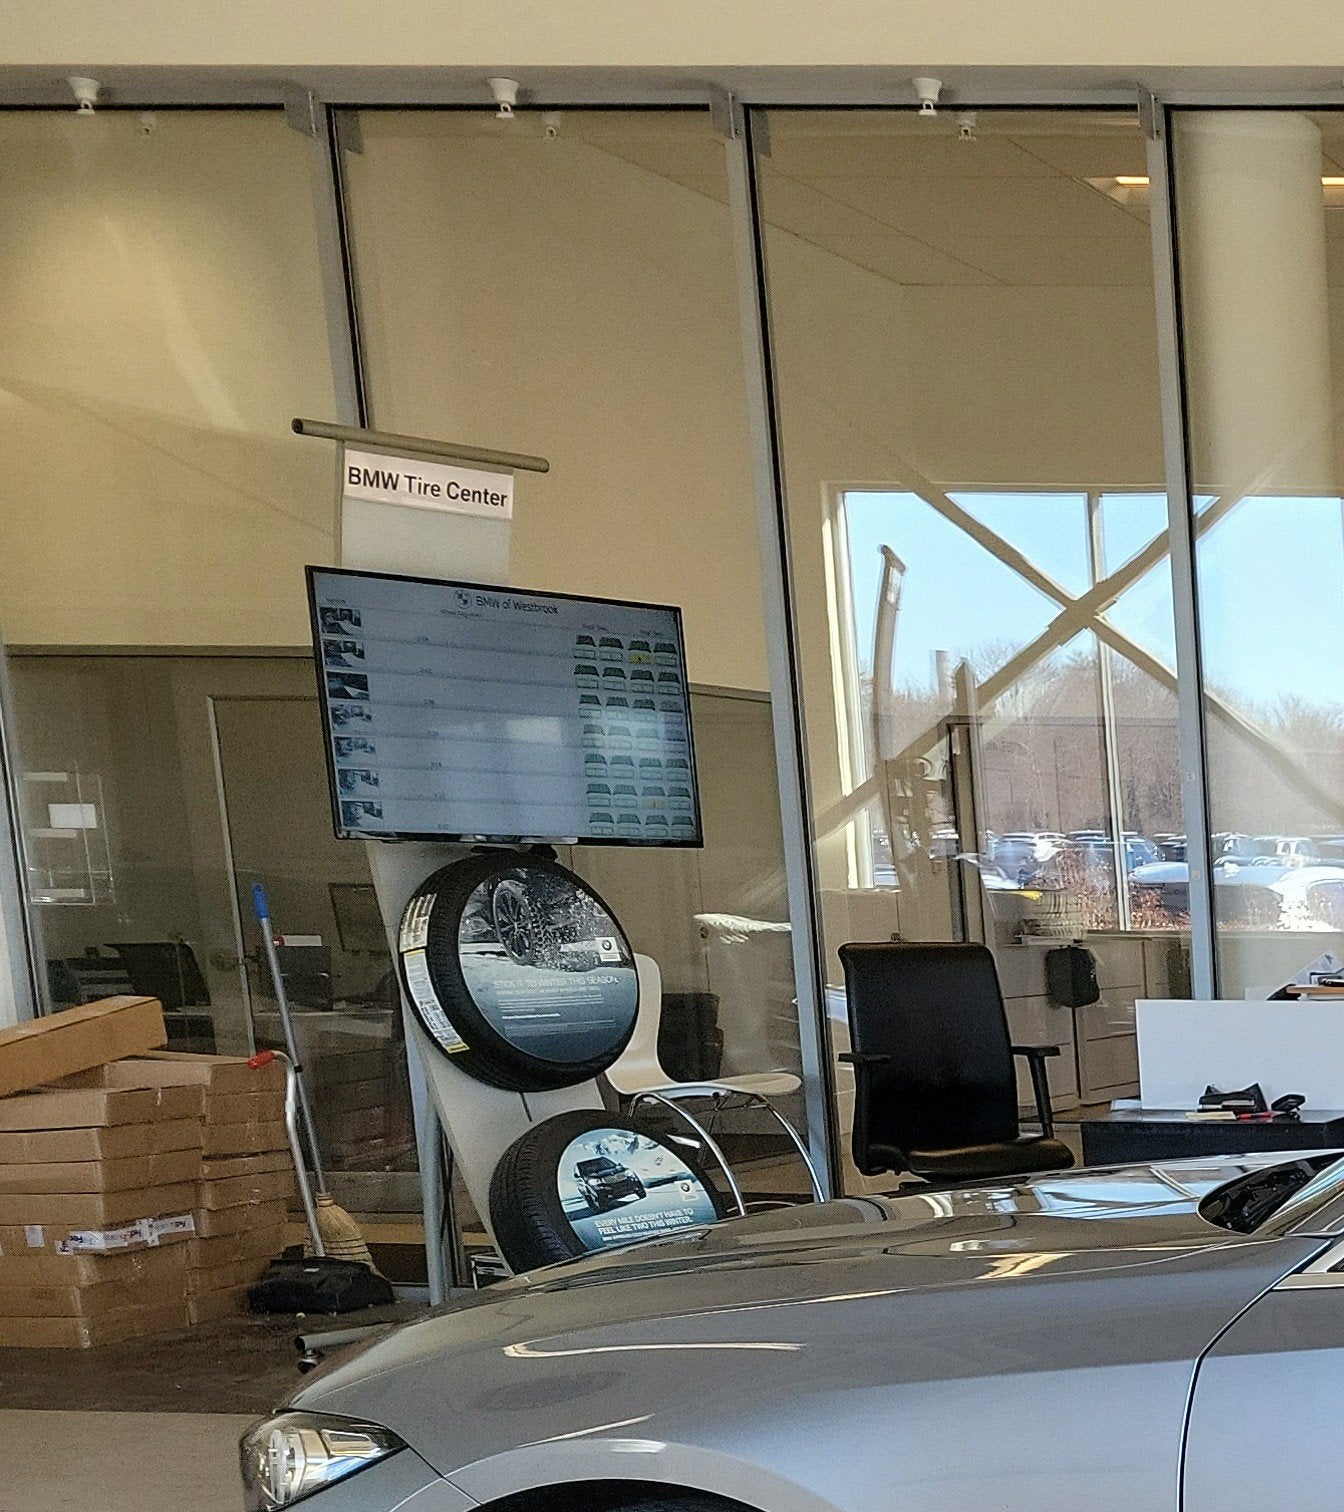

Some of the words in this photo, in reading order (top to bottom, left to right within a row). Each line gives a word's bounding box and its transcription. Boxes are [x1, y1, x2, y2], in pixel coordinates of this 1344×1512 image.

[348, 466, 399, 491] BMW
[404, 474, 441, 497] Tire
[446, 481, 508, 507] Center
